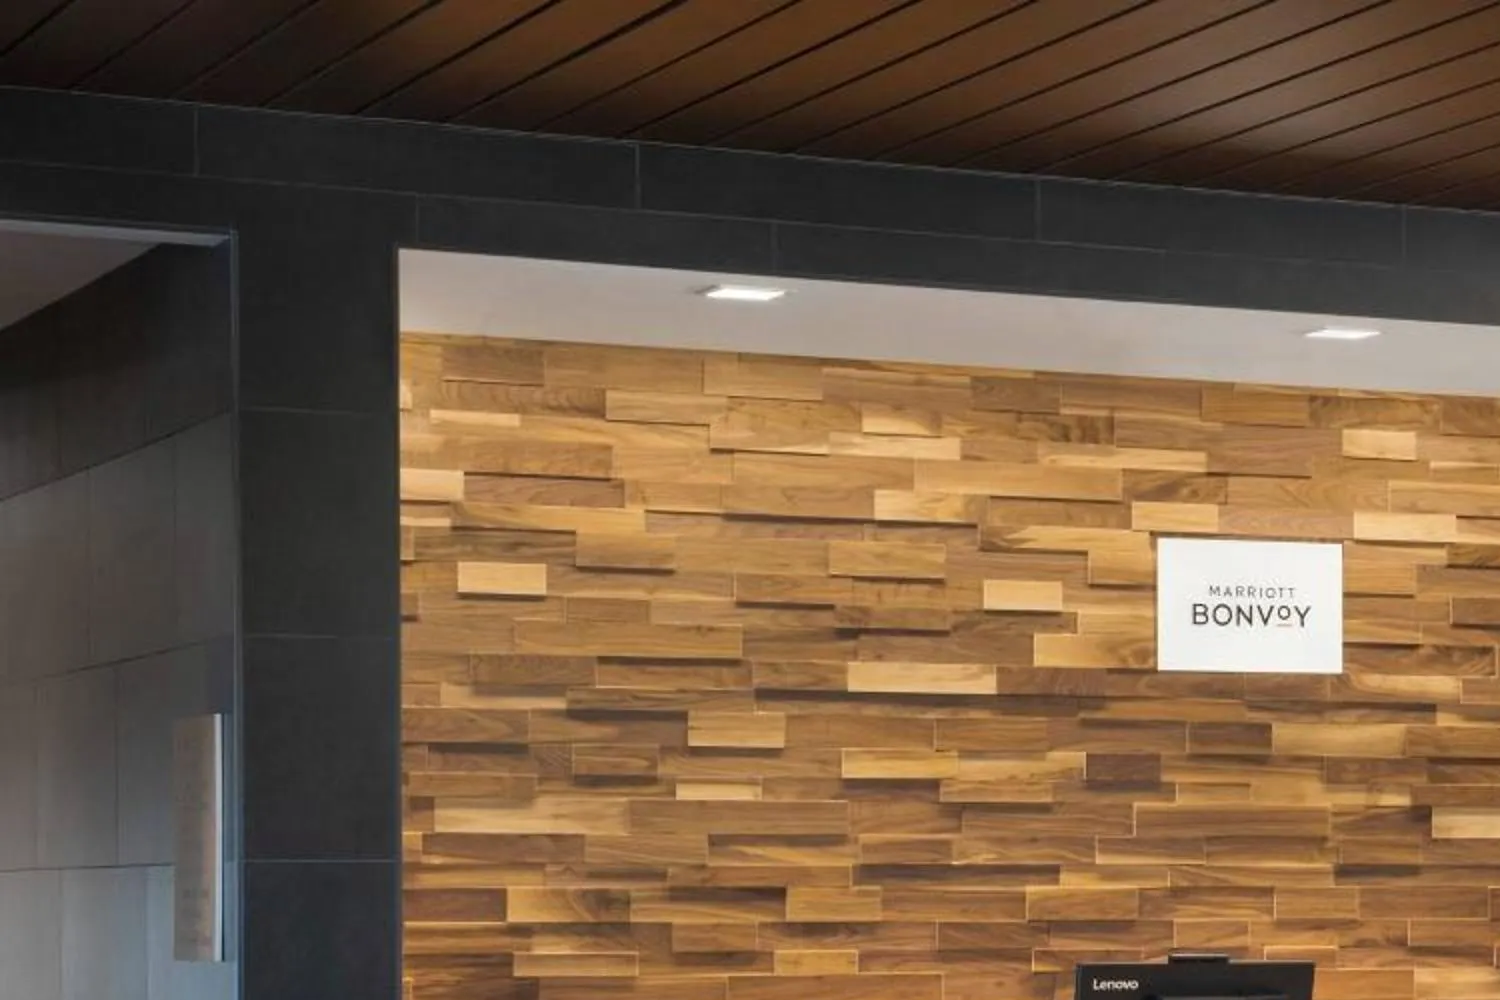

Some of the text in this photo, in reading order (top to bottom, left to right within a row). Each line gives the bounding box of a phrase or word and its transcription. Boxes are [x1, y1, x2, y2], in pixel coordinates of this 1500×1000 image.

[1208, 585, 1297, 599] MARRIOTT
[1192, 603, 1312, 628] BONVOY
[1093, 978, 1140, 991] Lenovo
